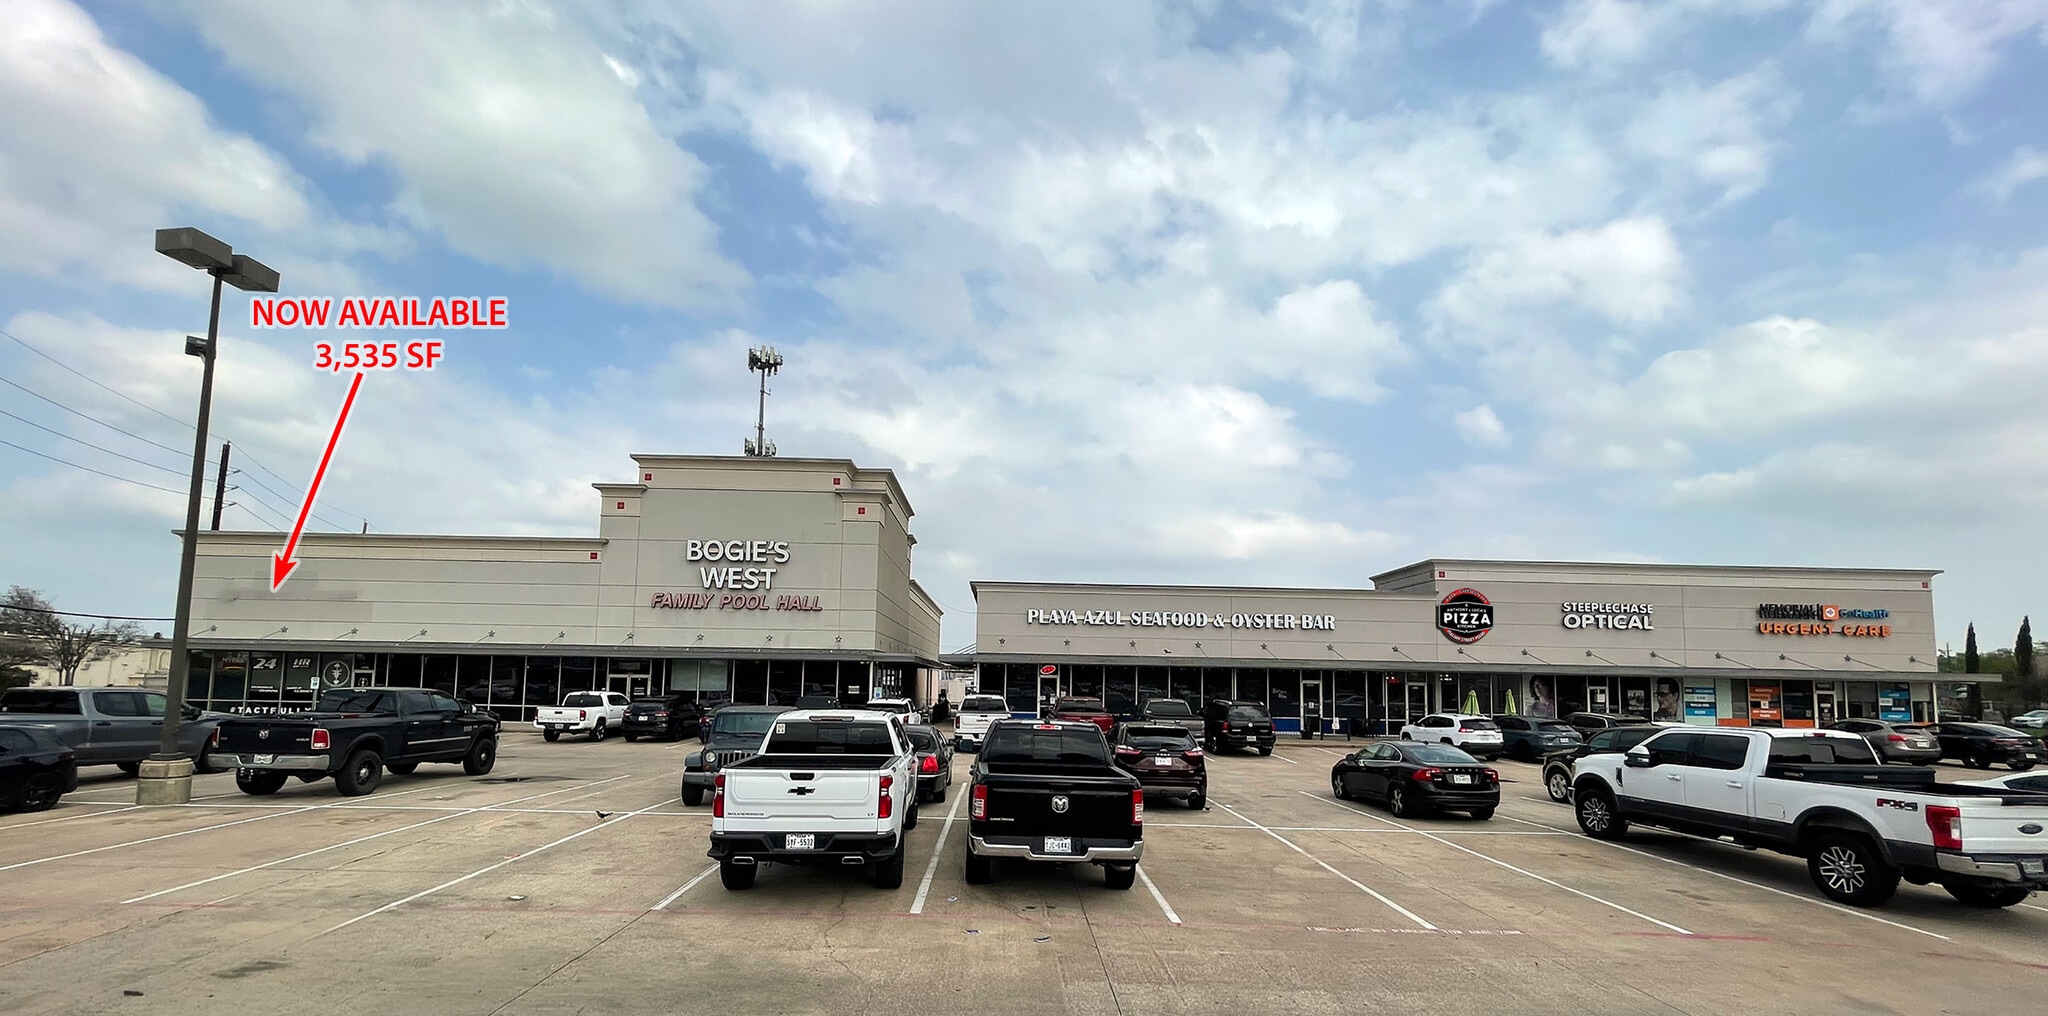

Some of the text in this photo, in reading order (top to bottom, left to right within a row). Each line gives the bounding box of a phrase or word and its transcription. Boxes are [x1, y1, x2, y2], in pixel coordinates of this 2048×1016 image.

[686, 539, 791, 563] BOGIE'S
[700, 566, 777, 590] WEST
[651, 592, 823, 612] FAMILY POOL HALL
[1563, 601, 1654, 614] STEEPLECHASE
[1026, 608, 1336, 631] PLAYA AZUL SEAFOOD & OYSTER BAR
[1443, 612, 1491, 625] PIZZA
[1563, 613, 1655, 630] OPTICAL
[1759, 622, 1891, 637] URGENT CARE
[253, 658, 277, 669] 24
